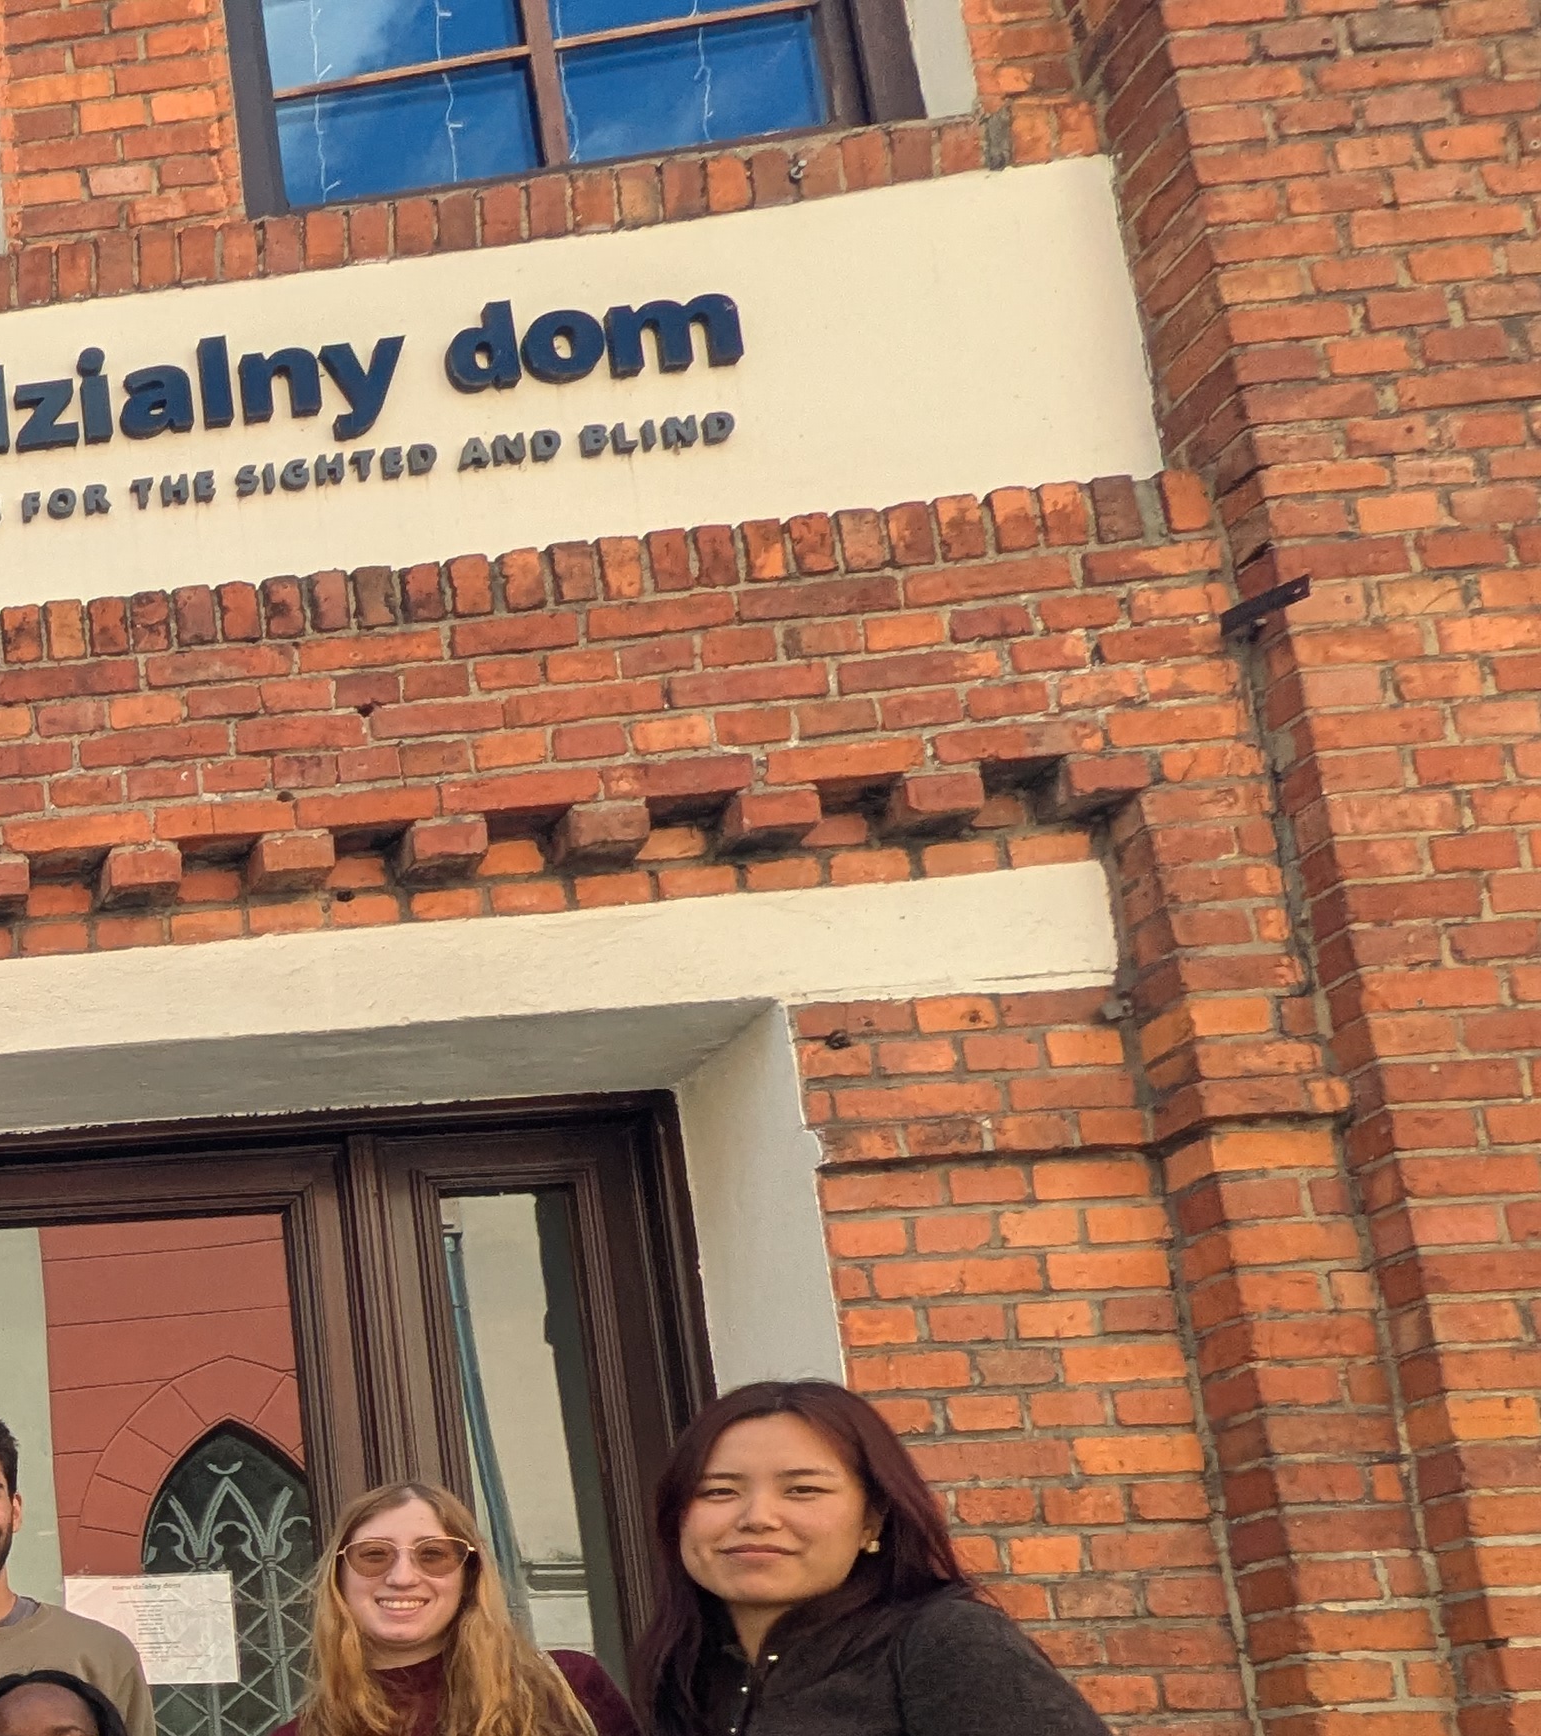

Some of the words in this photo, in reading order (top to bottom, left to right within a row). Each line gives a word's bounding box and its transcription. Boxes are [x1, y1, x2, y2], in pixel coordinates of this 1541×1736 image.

[445, 292, 744, 394] dom
[21, 482, 111, 524] FOR
[129, 470, 217, 510] THE
[235, 442, 437, 498] SIGHTED
[457, 429, 562, 472] AND
[578, 411, 737, 459] BLIND
